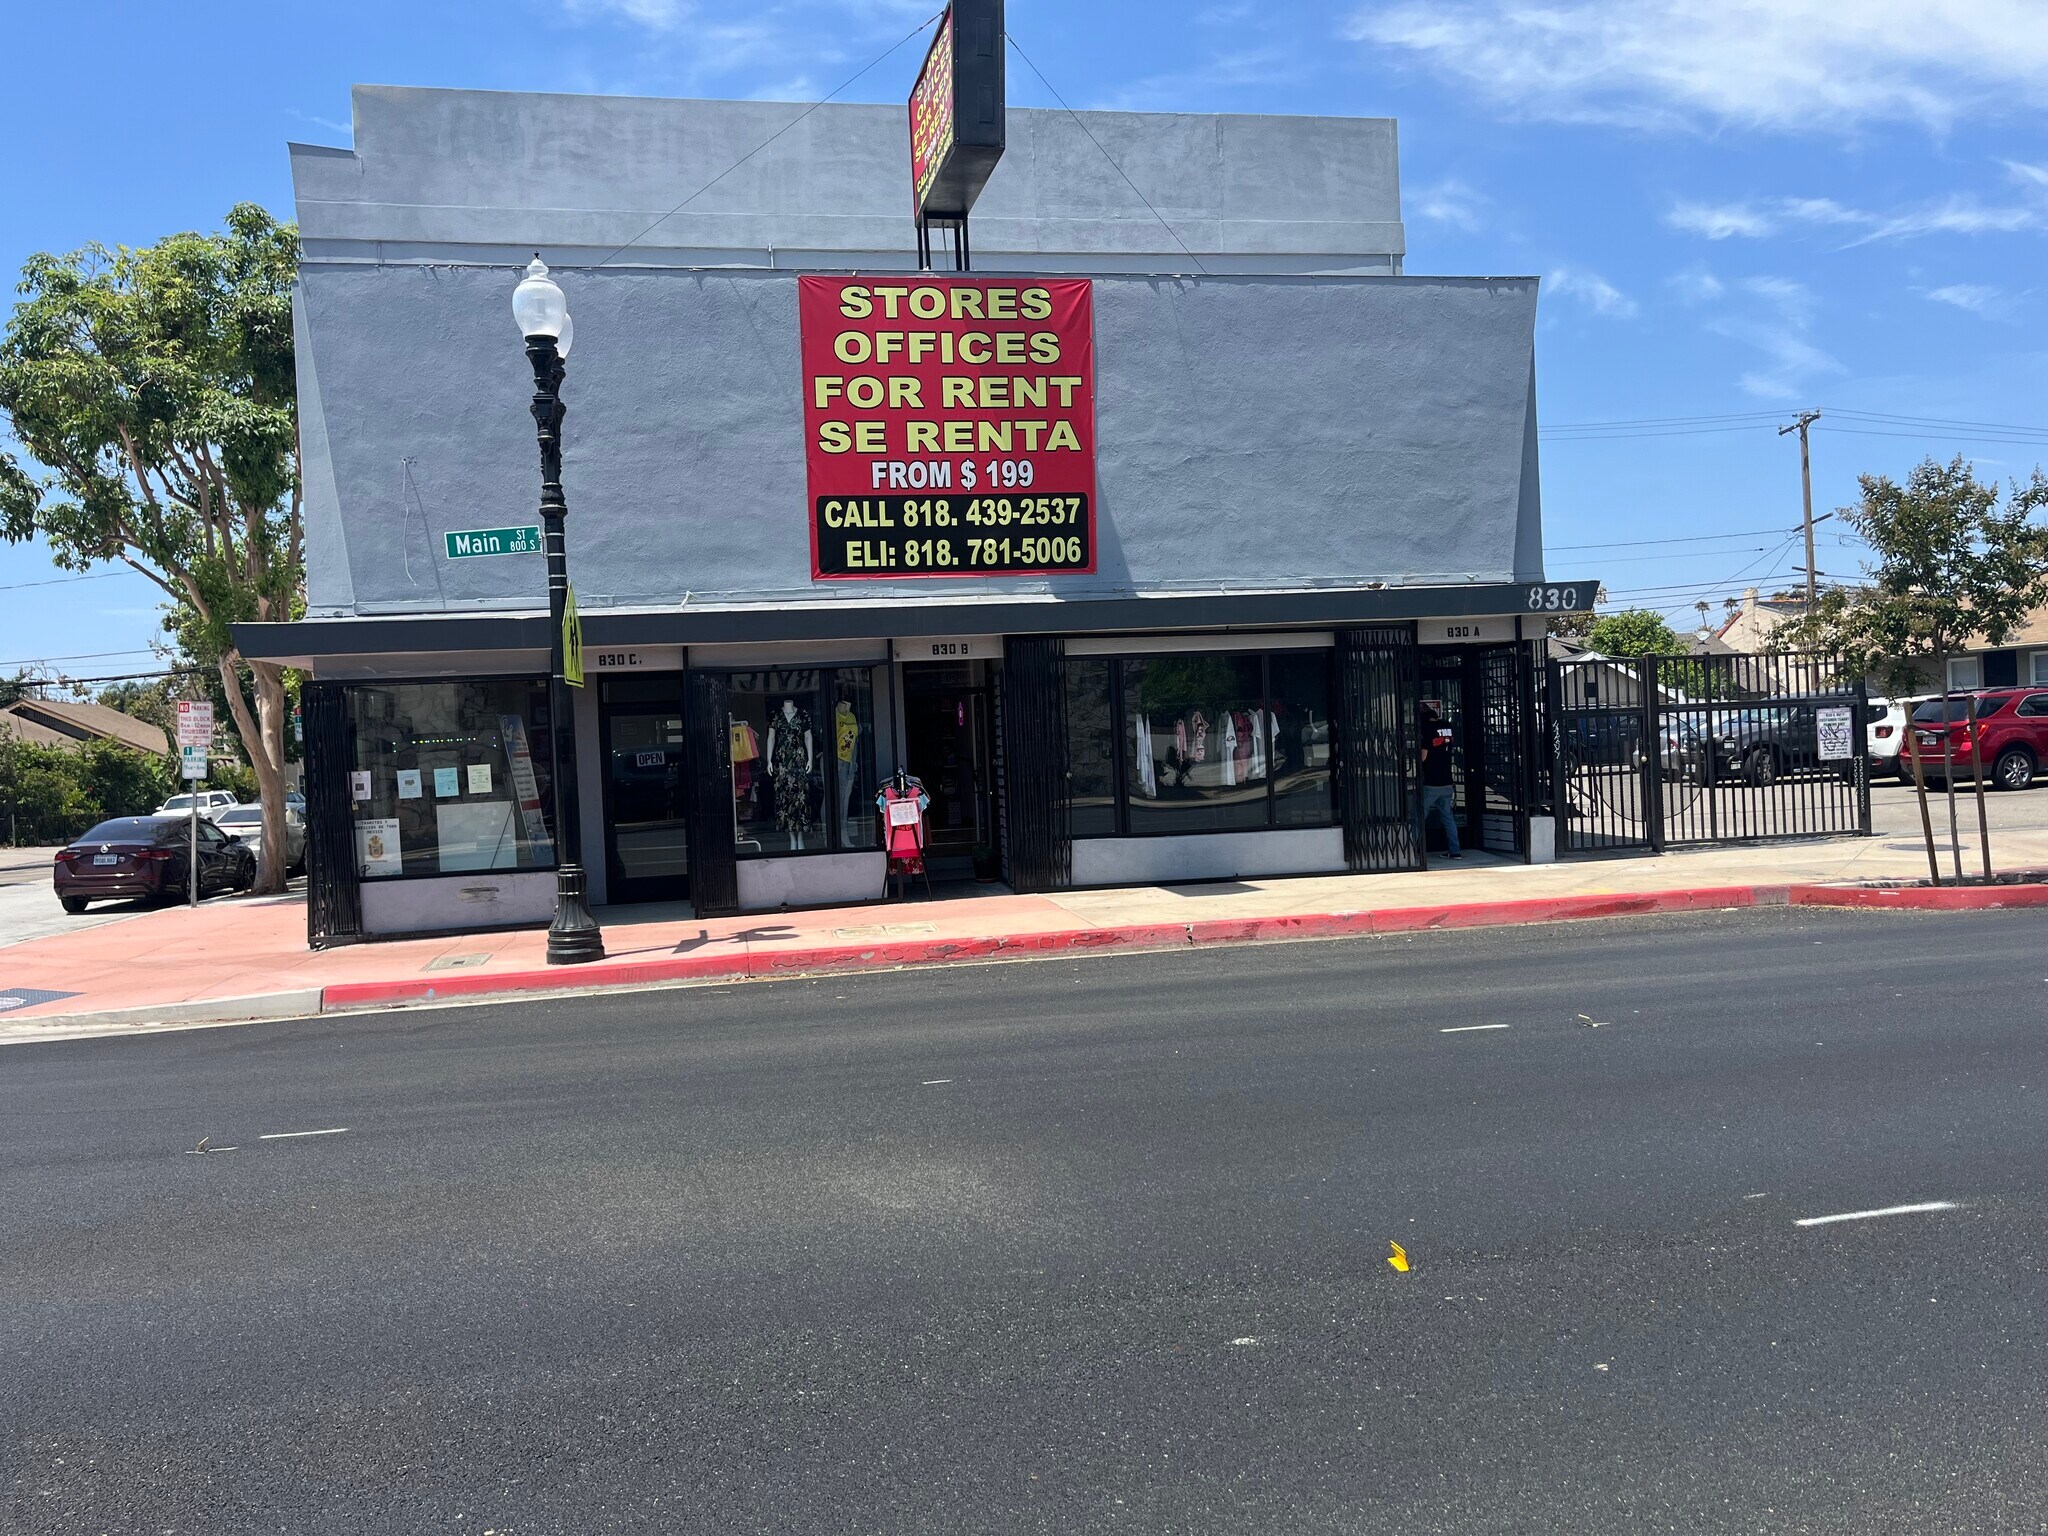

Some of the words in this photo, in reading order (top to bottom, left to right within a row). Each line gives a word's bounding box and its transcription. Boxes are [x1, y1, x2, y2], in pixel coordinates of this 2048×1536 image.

[914, 107, 932, 146] FOR
[916, 136, 928, 162] SE
[840, 286, 1052, 319] STORES
[833, 331, 1060, 364] OFFICES
[814, 376, 925, 409] FOR
[942, 376, 1082, 408] RENT
[818, 420, 887, 454] SE
[906, 420, 1082, 453] RENTA
[871, 460, 951, 489] FROM
[960, 459, 977, 492] $
[986, 459, 1034, 488] 199
[825, 500, 894, 528] CALL
[903, 500, 957, 526] 818.
[966, 498, 1080, 526] 439-2537
[455, 533, 500, 554] Main
[510, 541, 526, 551] 800
[530, 540, 535, 550] S
[516, 530, 525, 540] ST
[846, 540, 896, 567] ELI:
[905, 539, 958, 566] 818.
[967, 537, 1081, 565] 781-5006
[1528, 587, 1576, 610] 830
[1448, 627, 1468, 637] 830
[1474, 626, 1480, 636] A
[599, 654, 624, 666] 830
[932, 644, 956, 655] 830
[961, 644, 968, 654] B
[639, 753, 662, 765] OPEN
